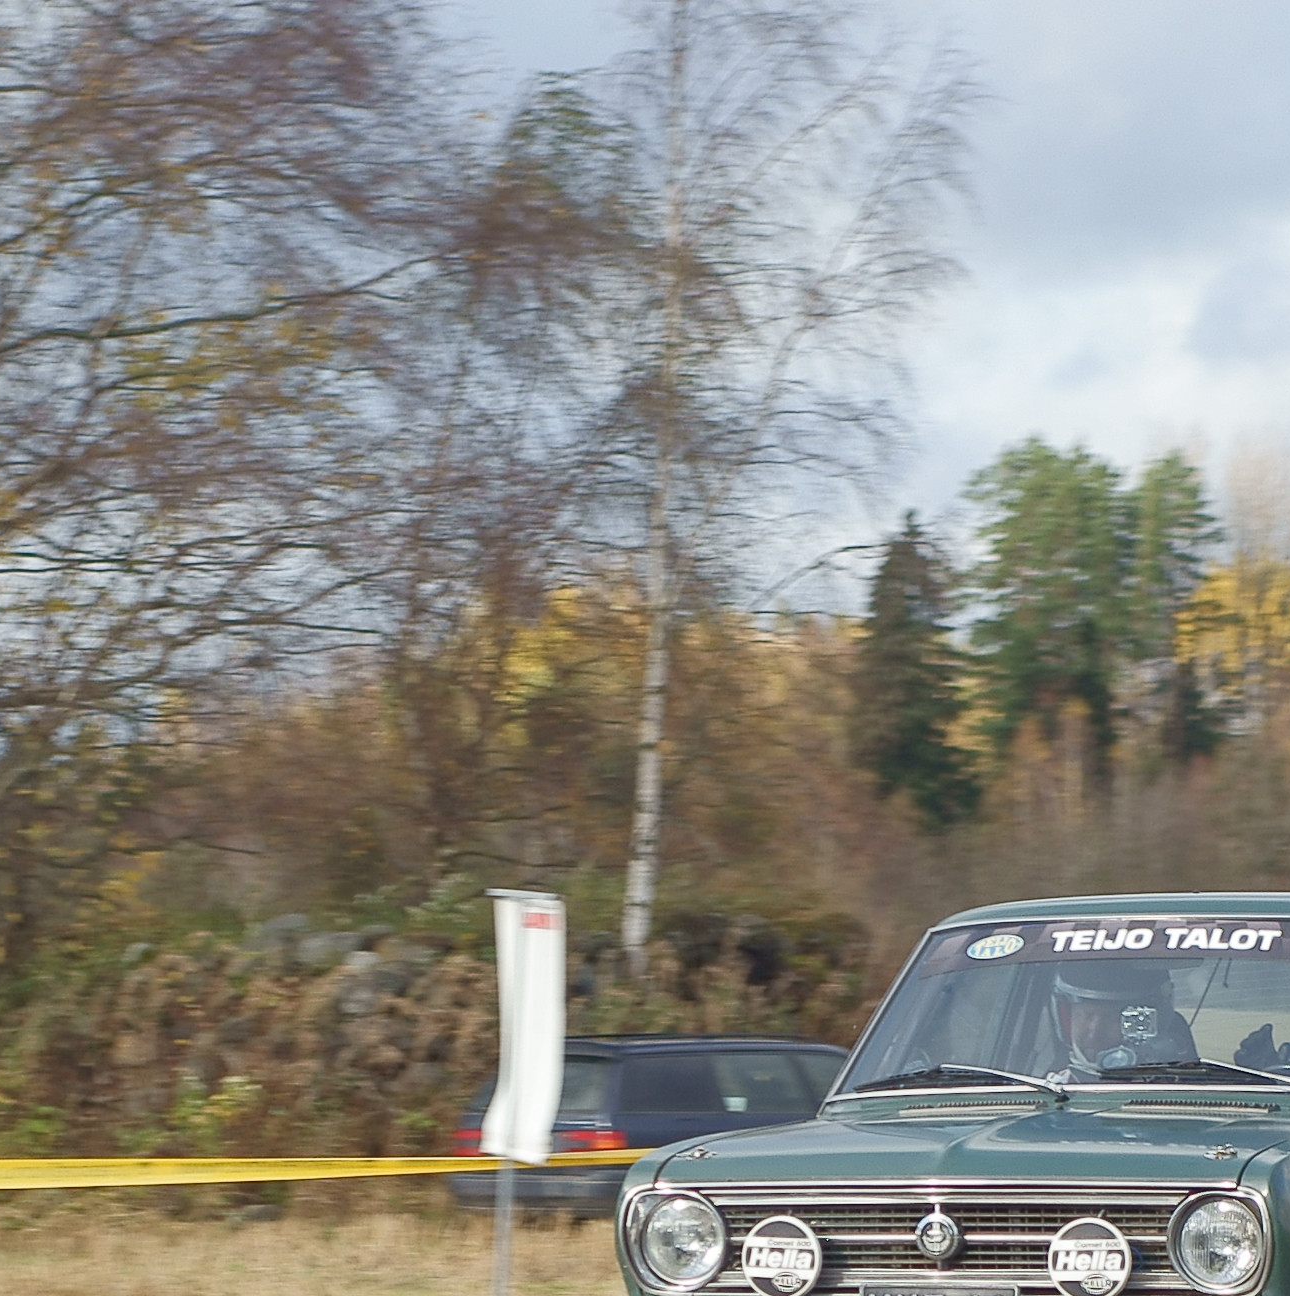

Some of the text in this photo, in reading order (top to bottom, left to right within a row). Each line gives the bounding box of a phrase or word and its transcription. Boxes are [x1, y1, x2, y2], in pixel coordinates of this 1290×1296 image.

[1051, 928, 1282, 952] TEIJO TALOT
[748, 1247, 814, 1270] Hella
[1055, 1250, 1123, 1271] Hella
